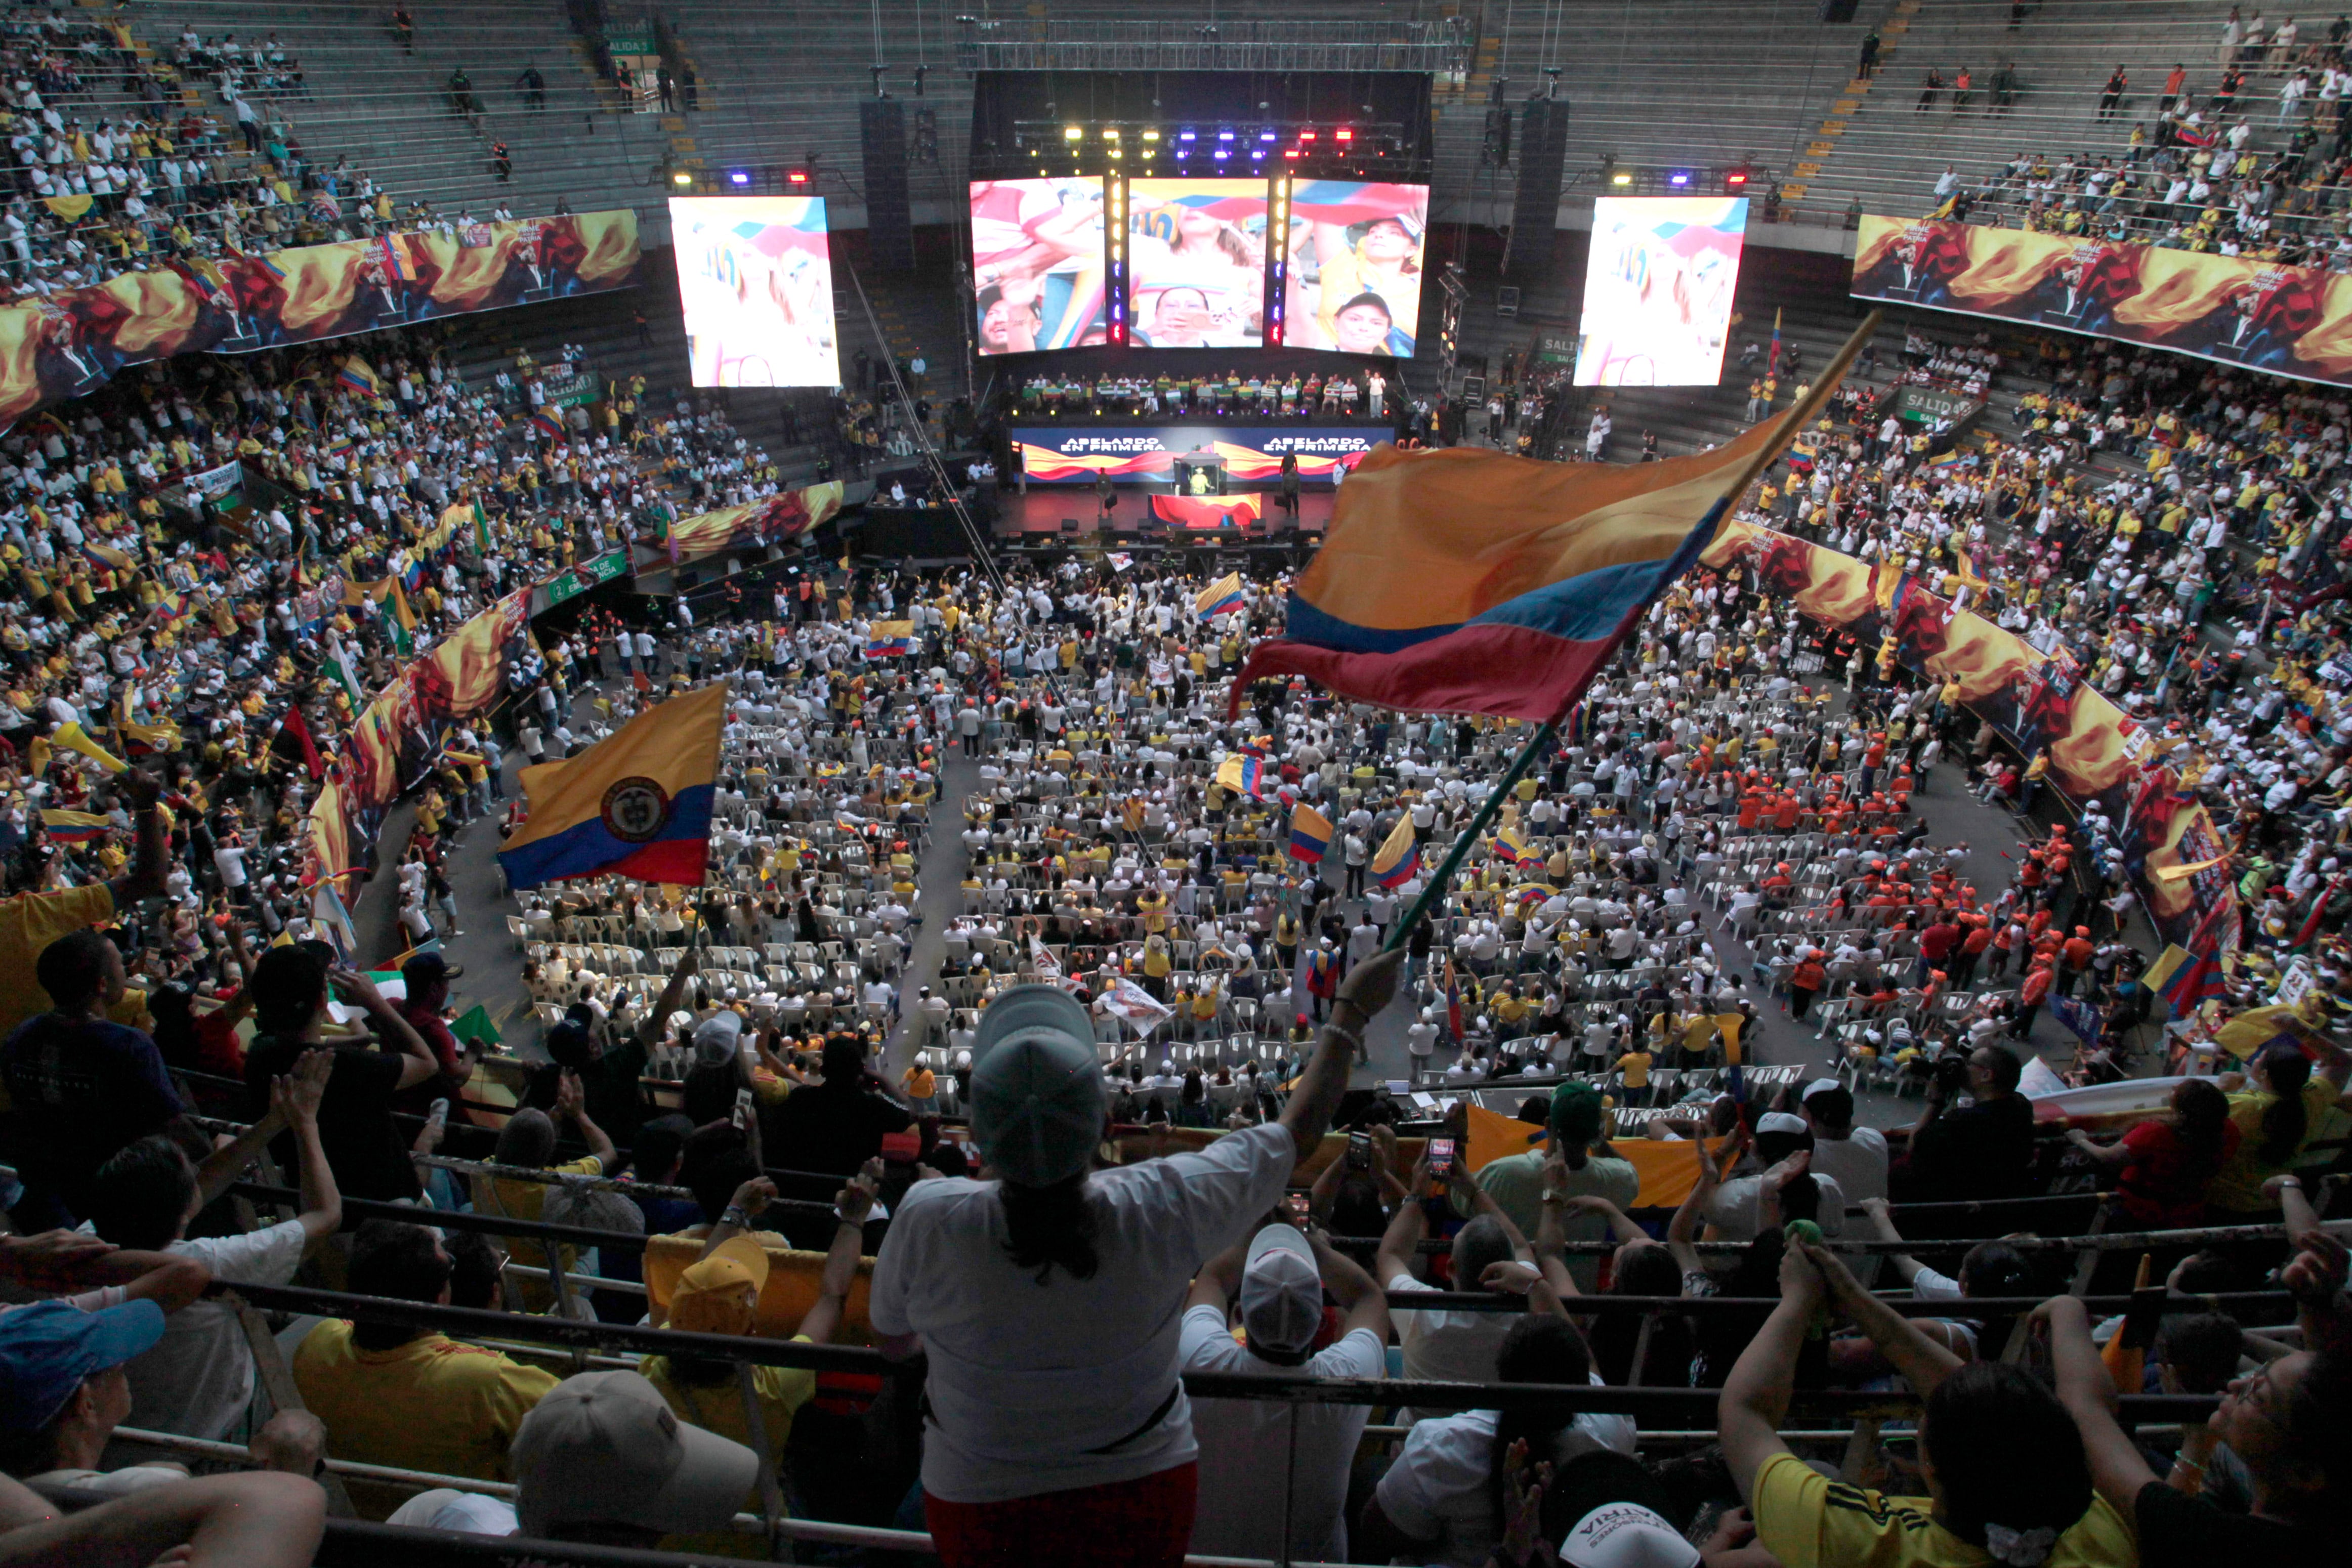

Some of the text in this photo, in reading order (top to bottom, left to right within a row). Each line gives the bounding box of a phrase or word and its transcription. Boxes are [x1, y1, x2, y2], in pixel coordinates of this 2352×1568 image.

[609, 41, 640, 51] ALIDA
[1905, 225, 1930, 233] FIRME
[1903, 234, 1927, 243] PATRIA
[2075, 243, 2102, 253] FIRME
[2071, 255, 2097, 264] PATRIA
[2256, 269, 2286, 281] FIRME
[2249, 281, 2278, 292] PATRIA
[1545, 339, 1579, 351] SALI
[556, 399, 576, 408] ALIDA
[1751, 542, 1772, 554] PATRIA
[599, 560, 610, 571] DE
[568, 566, 617, 593] EMNCIA
[556, 583, 562, 595] 2
[1579, 1508, 1651, 1535] ATRIA
